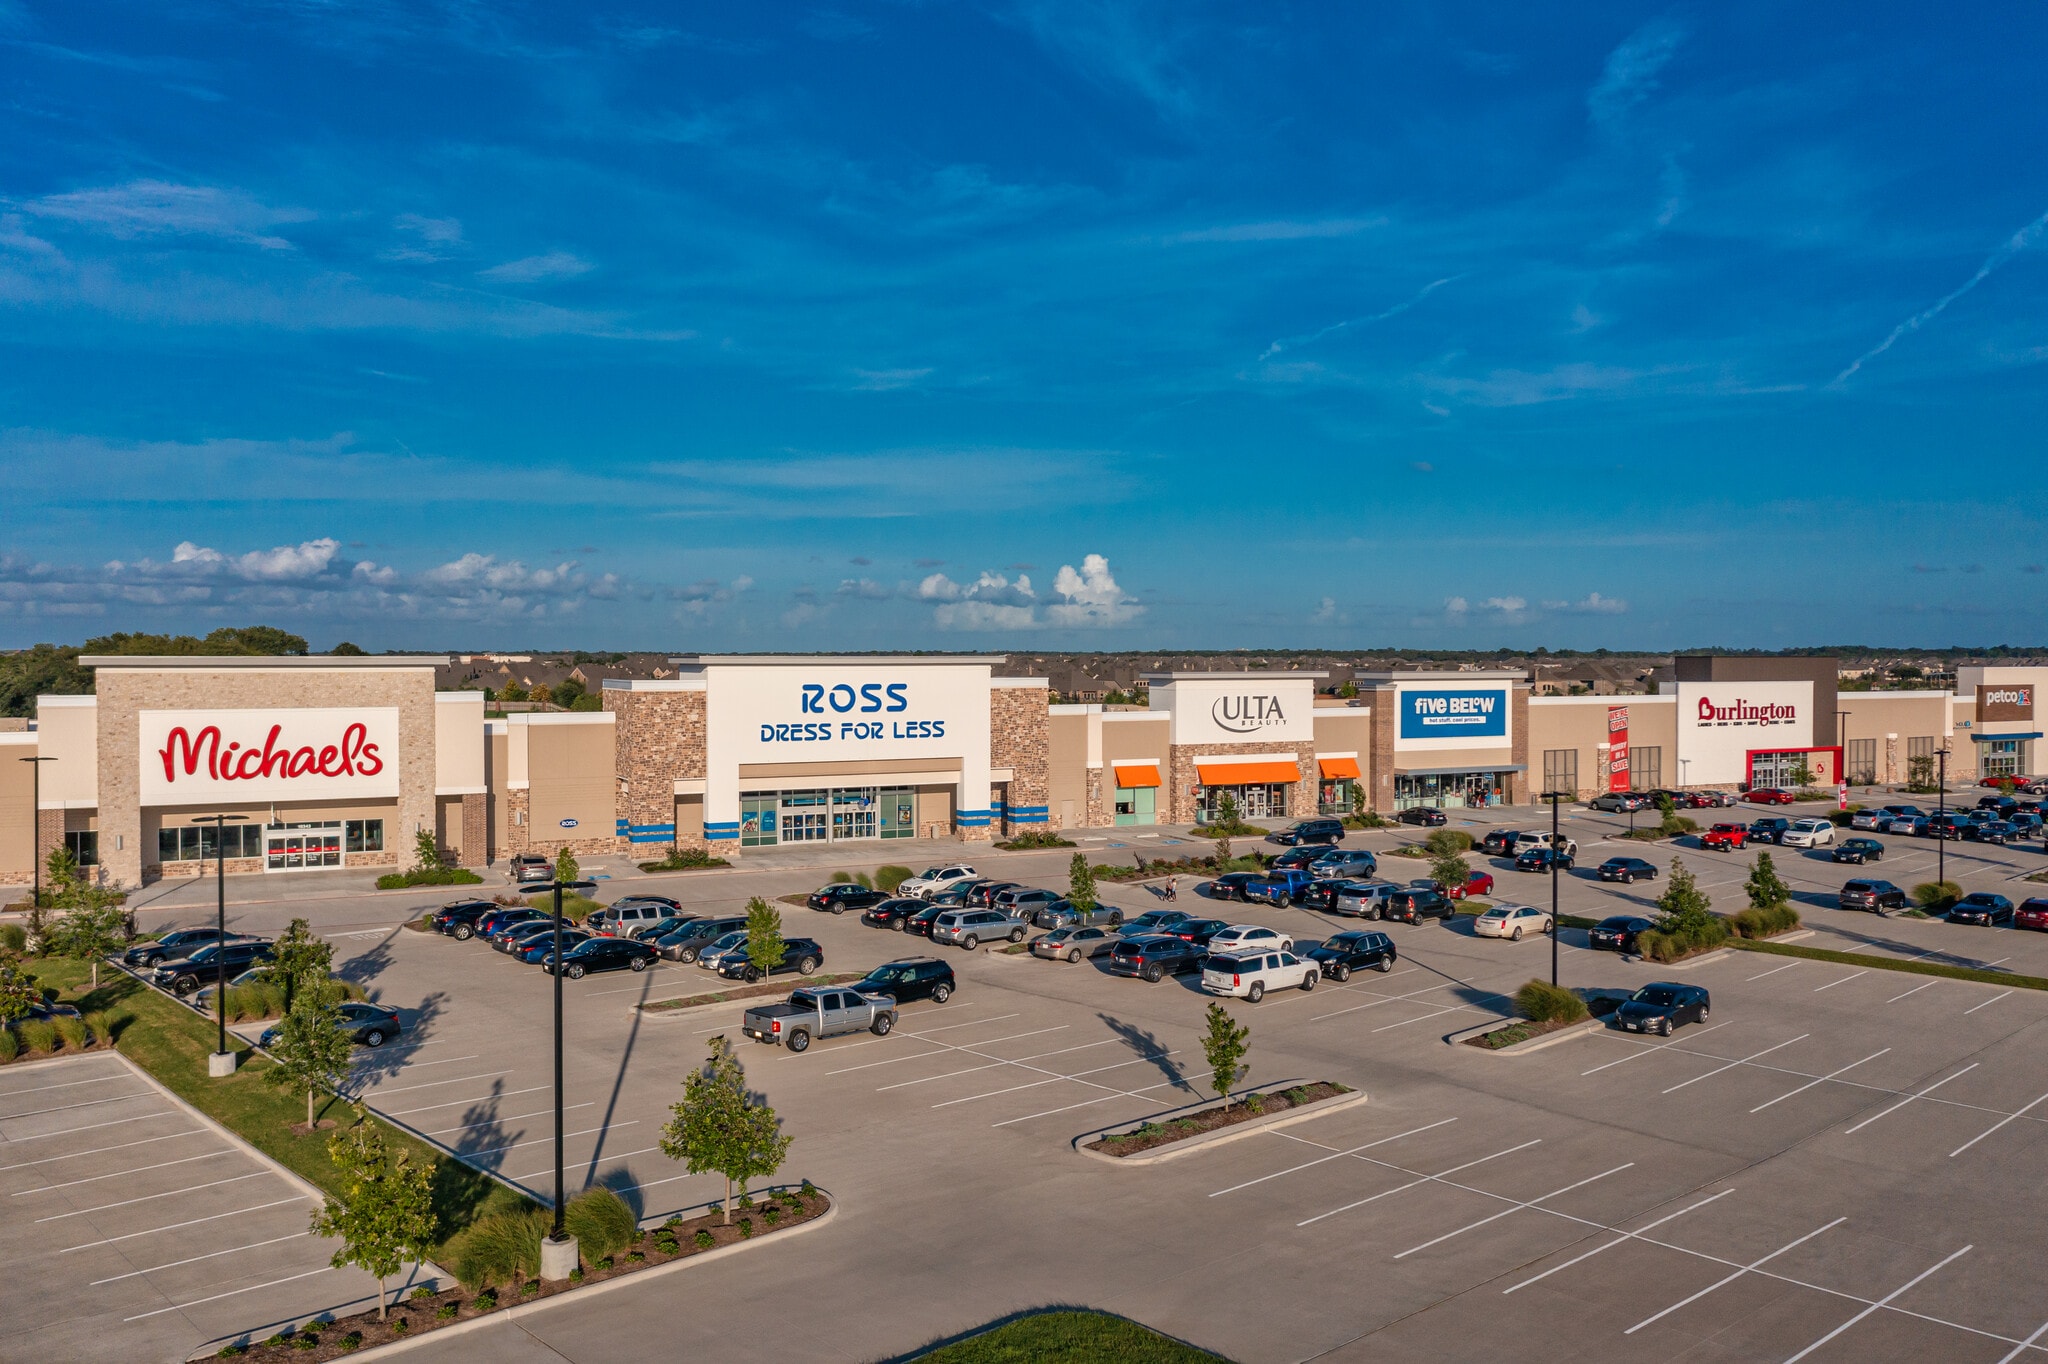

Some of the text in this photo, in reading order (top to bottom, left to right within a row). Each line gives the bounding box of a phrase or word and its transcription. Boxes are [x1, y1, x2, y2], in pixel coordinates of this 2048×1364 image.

[802, 683, 908, 714] ROSS
[1223, 695, 1284, 720] ULTA
[1414, 697, 1495, 714] five BELOW
[1986, 689, 2018, 707] petco
[1698, 697, 1796, 726] Burlington
[761, 721, 945, 743] DRESS FOR LESS
[1610, 719, 1627, 731] OPEN
[159, 722, 384, 783] Michaels
[1612, 759, 1628, 771] SAVE
[348, 932, 385, 941] STOP
